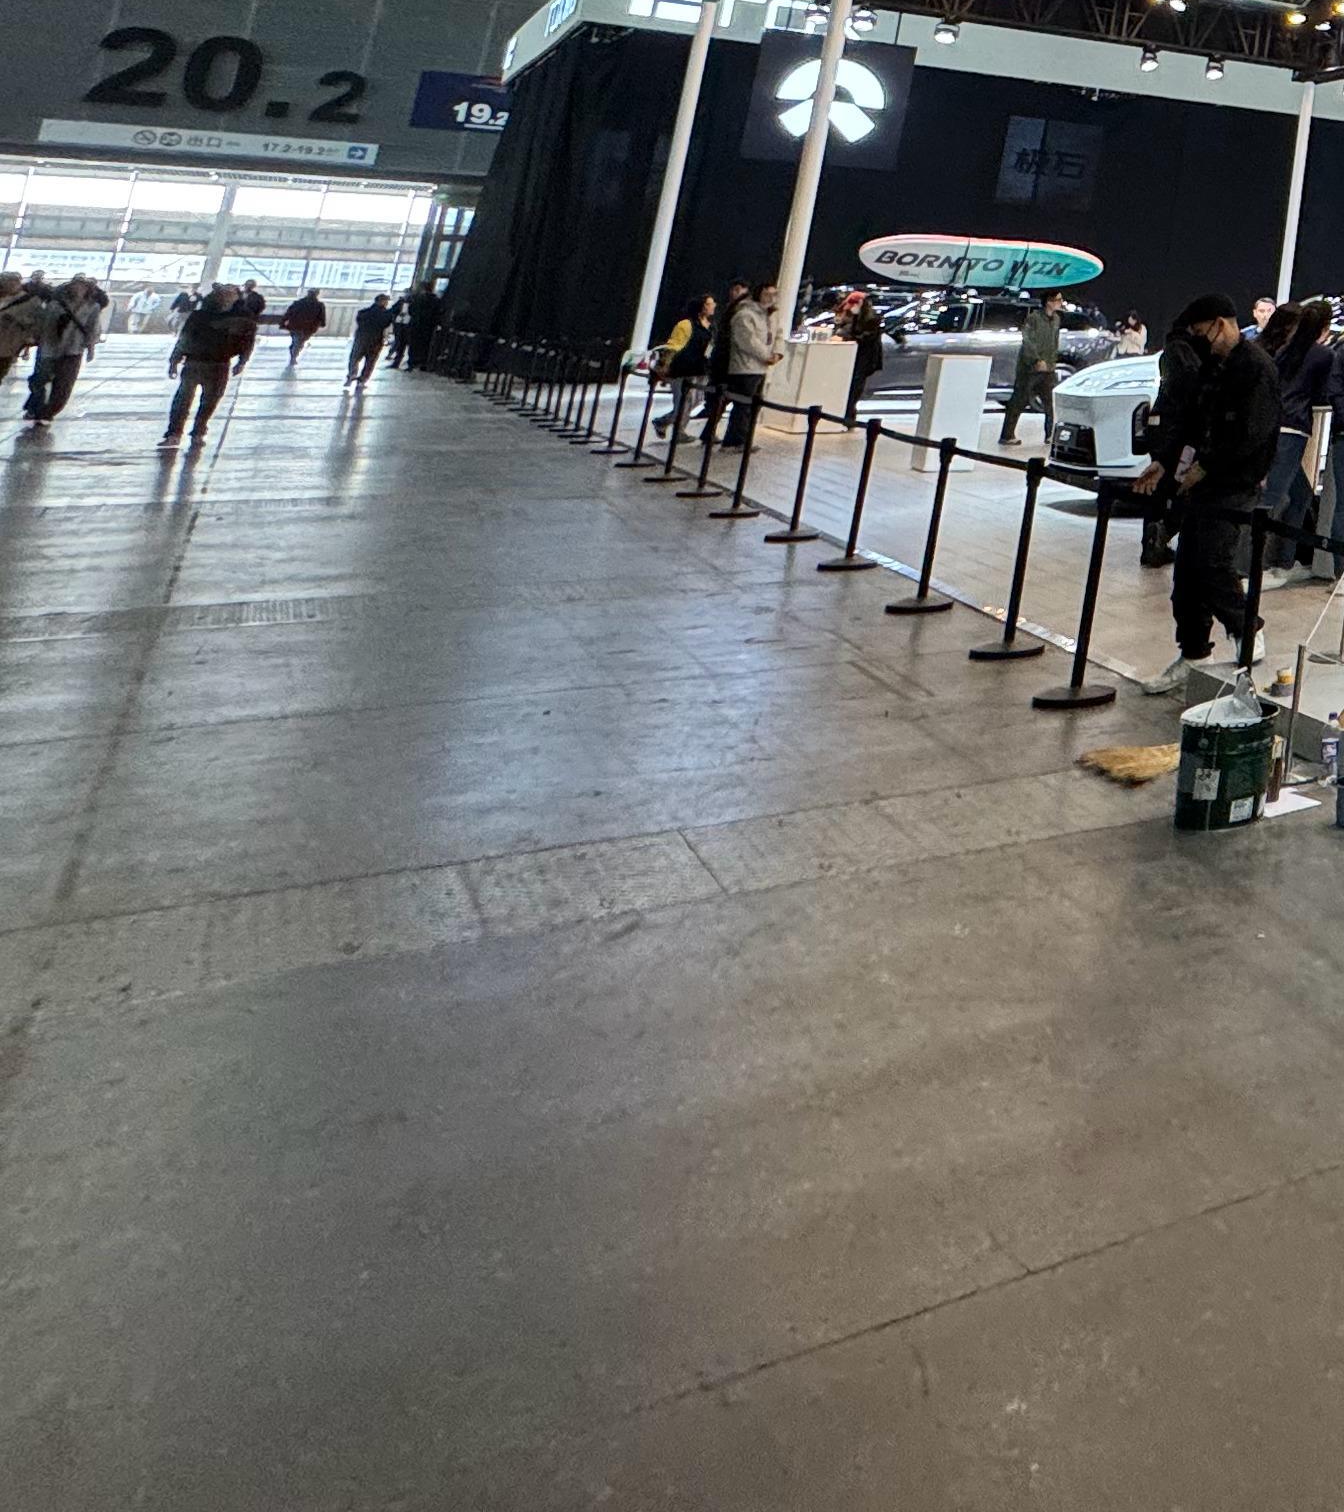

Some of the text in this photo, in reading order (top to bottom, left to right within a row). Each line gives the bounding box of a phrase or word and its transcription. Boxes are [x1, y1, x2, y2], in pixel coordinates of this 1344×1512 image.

[83, 26, 368, 124] 20.2
[452, 101, 510, 126] 19.2
[873, 250, 966, 272] BORN
[966, 257, 1004, 272] TO
